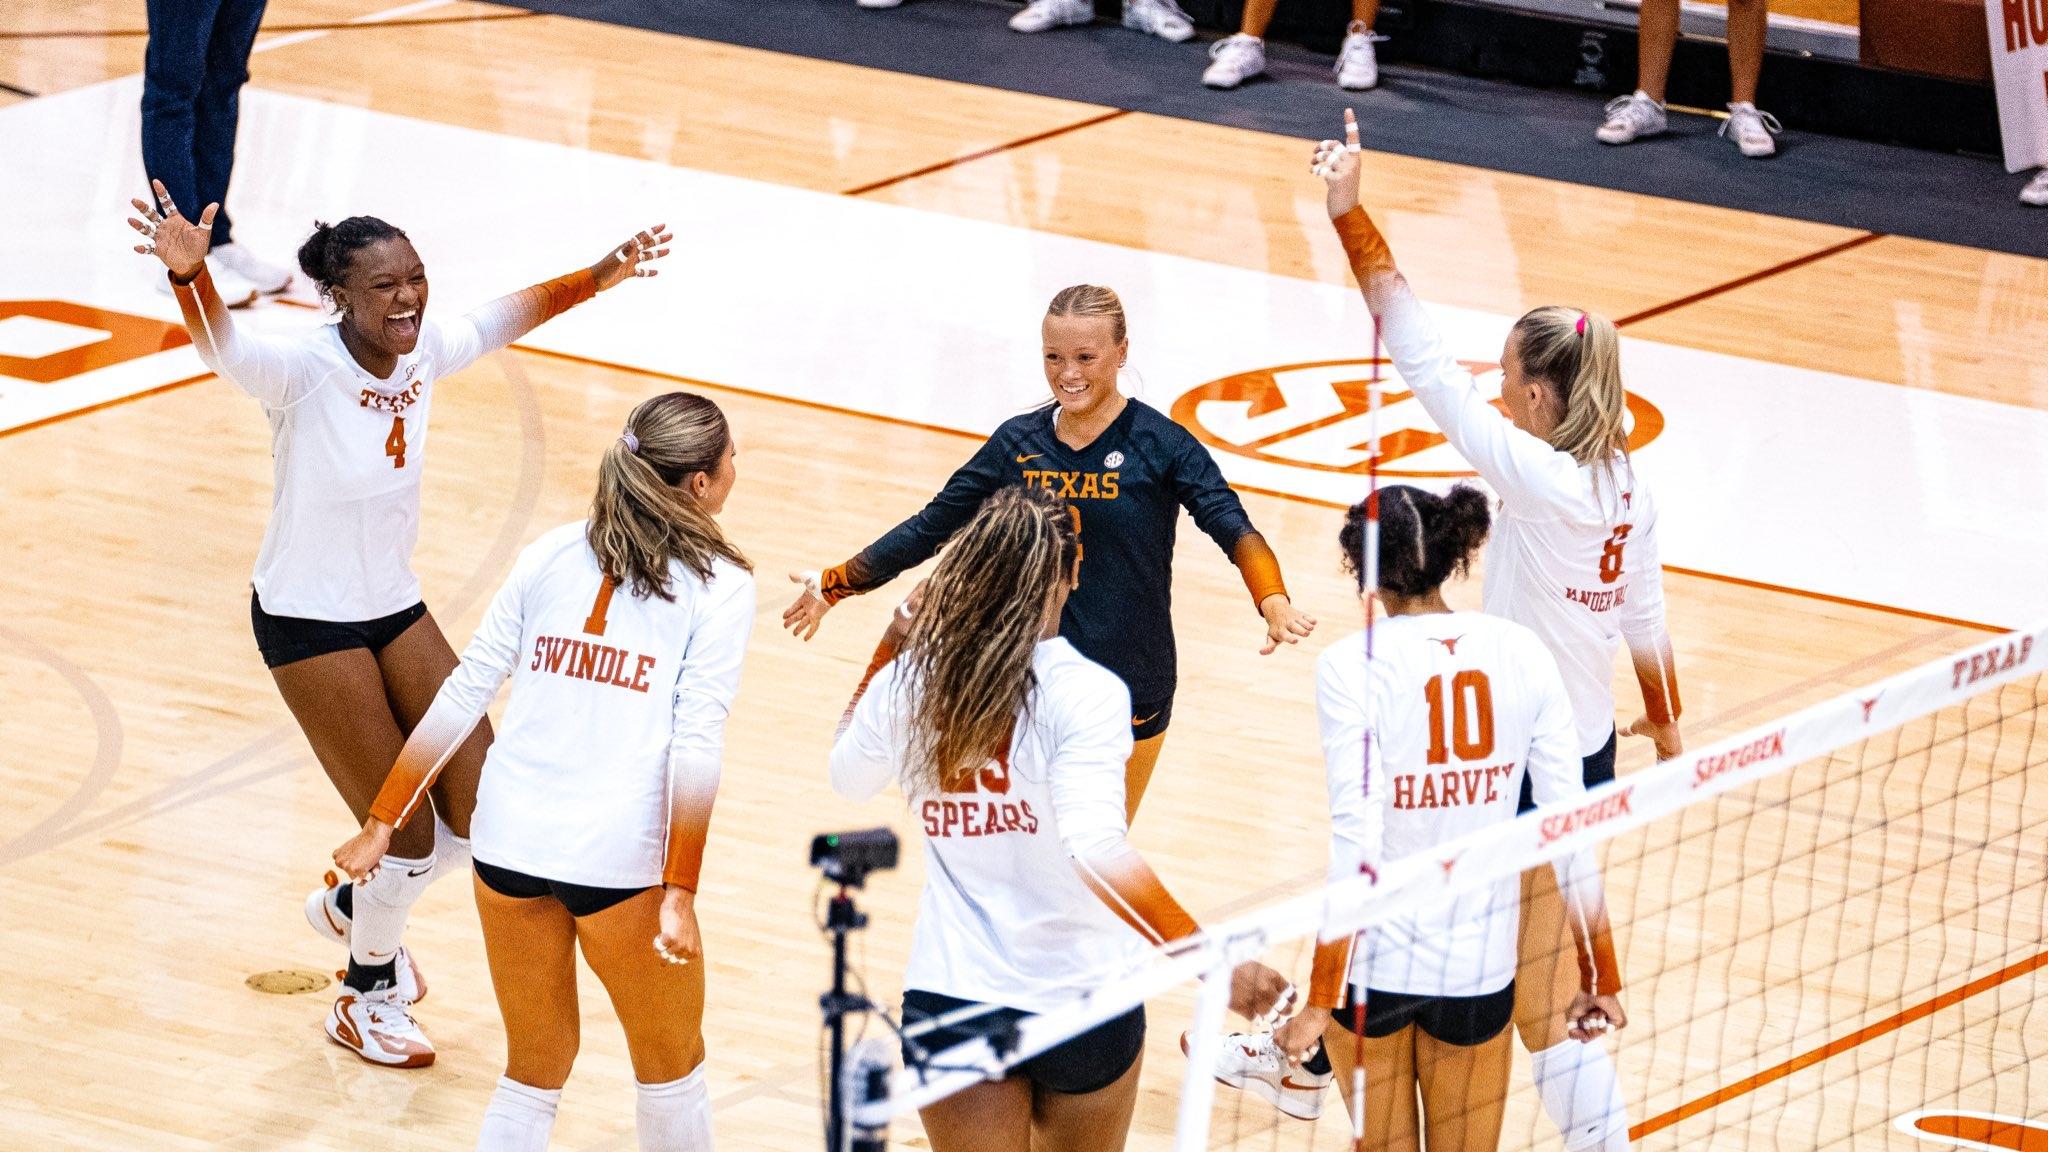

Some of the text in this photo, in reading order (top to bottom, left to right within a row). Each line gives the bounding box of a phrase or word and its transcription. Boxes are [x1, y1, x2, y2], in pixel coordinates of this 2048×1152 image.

[385, 416, 407, 469] 4
[1195, 368, 1635, 471] SE
[1022, 469, 1120, 499] TEXAS
[531, 635, 656, 693] SWINDLE
[1424, 669, 1495, 765] 10
[922, 799, 1038, 837] SPEARS
